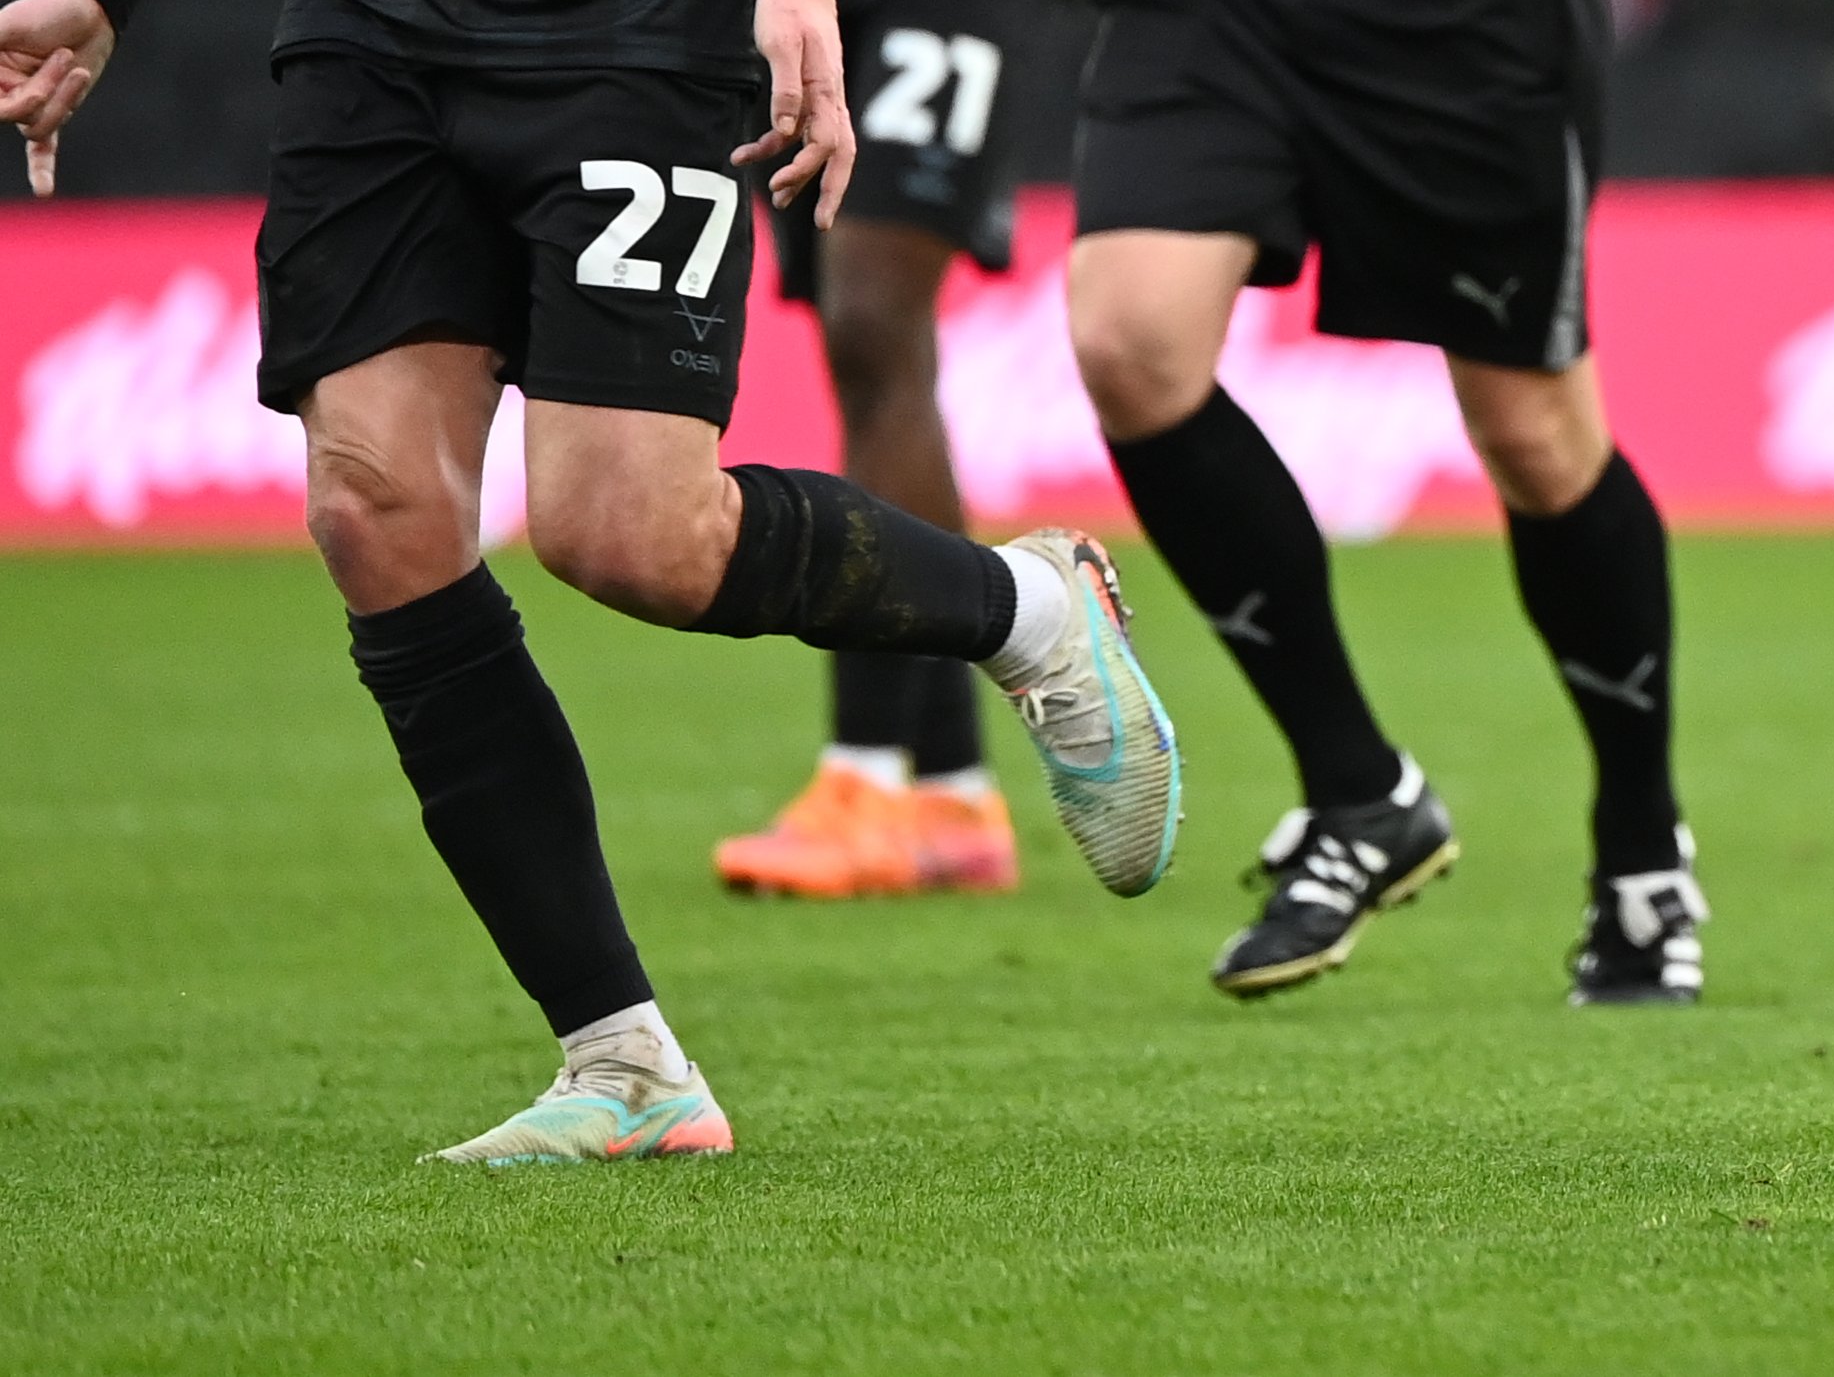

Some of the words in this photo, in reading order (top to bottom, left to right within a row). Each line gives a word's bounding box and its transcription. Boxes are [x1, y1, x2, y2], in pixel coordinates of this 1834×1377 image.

[861, 26, 1002, 155] 21
[576, 159, 738, 299] 27
[669, 349, 721, 376] OXEN
